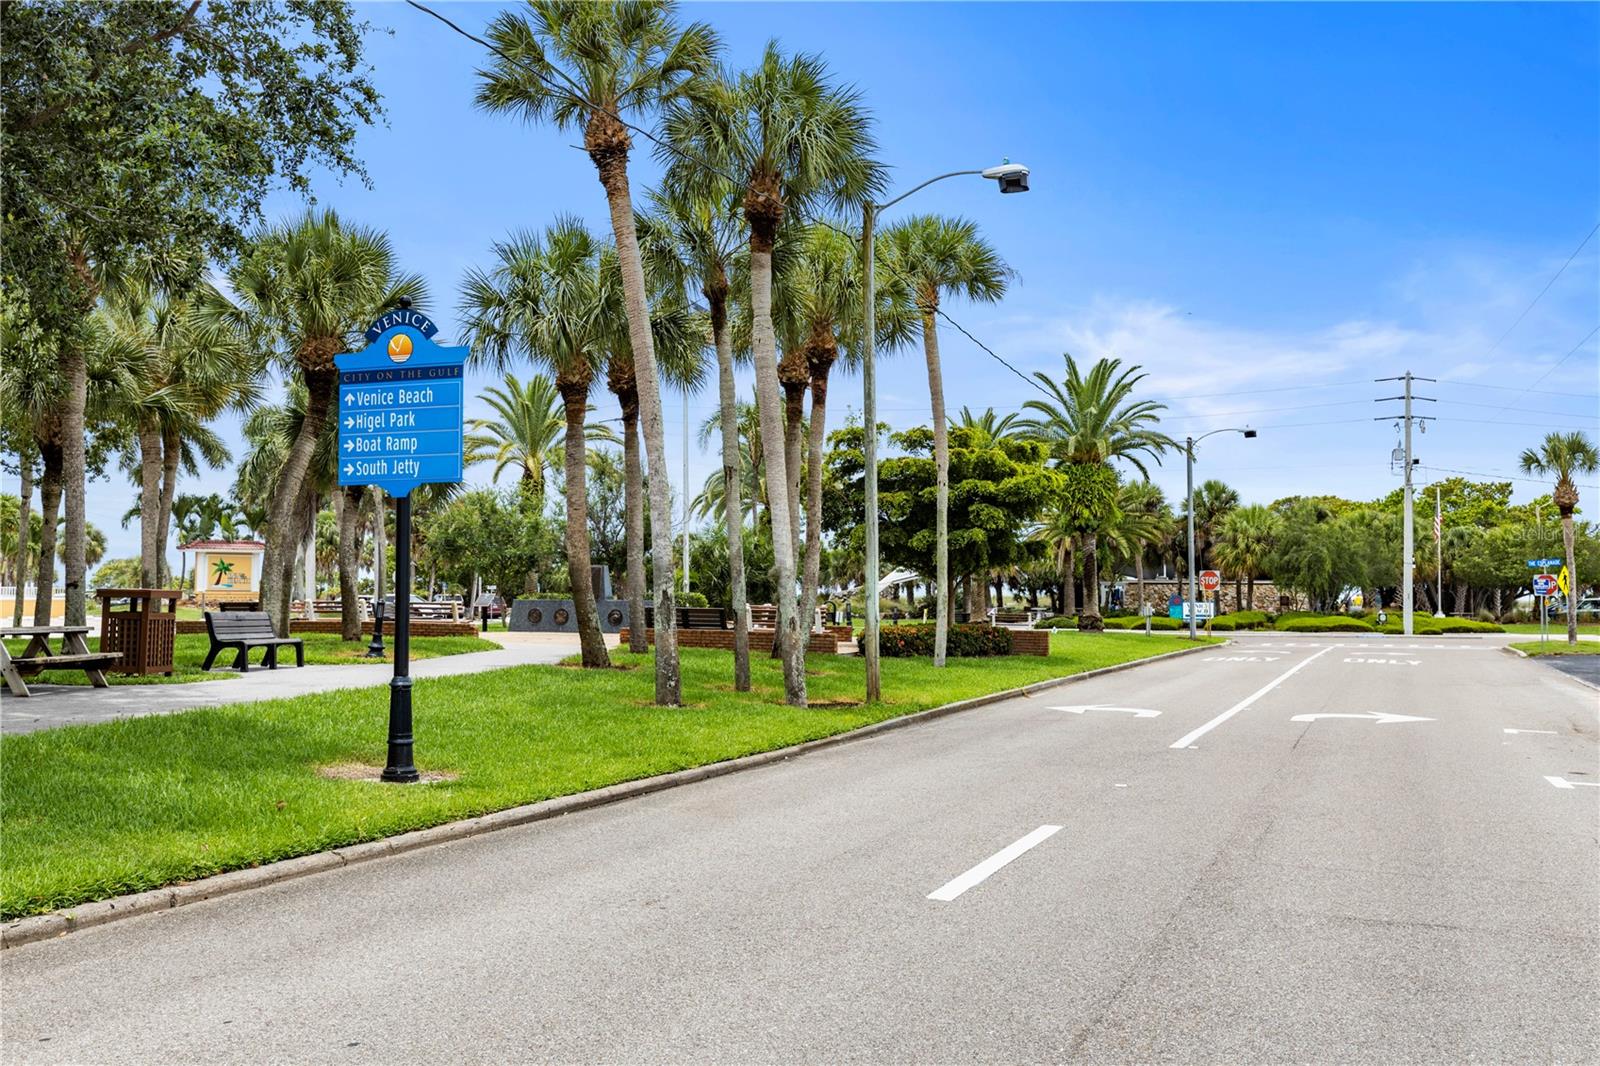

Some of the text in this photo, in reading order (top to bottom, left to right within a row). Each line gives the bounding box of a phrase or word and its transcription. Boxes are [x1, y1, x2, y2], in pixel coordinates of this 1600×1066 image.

[372, 312, 431, 335] VENICE
[344, 367, 460, 383] CITY ON THE GULF
[357, 387, 433, 407] Venice Beach
[356, 411, 416, 433] Higel Park
[356, 435, 418, 454] Boat Ramp
[356, 459, 420, 478] South Jetty
[1200, 576, 1219, 585] STOP
[1343, 657, 1423, 665] ONLY
